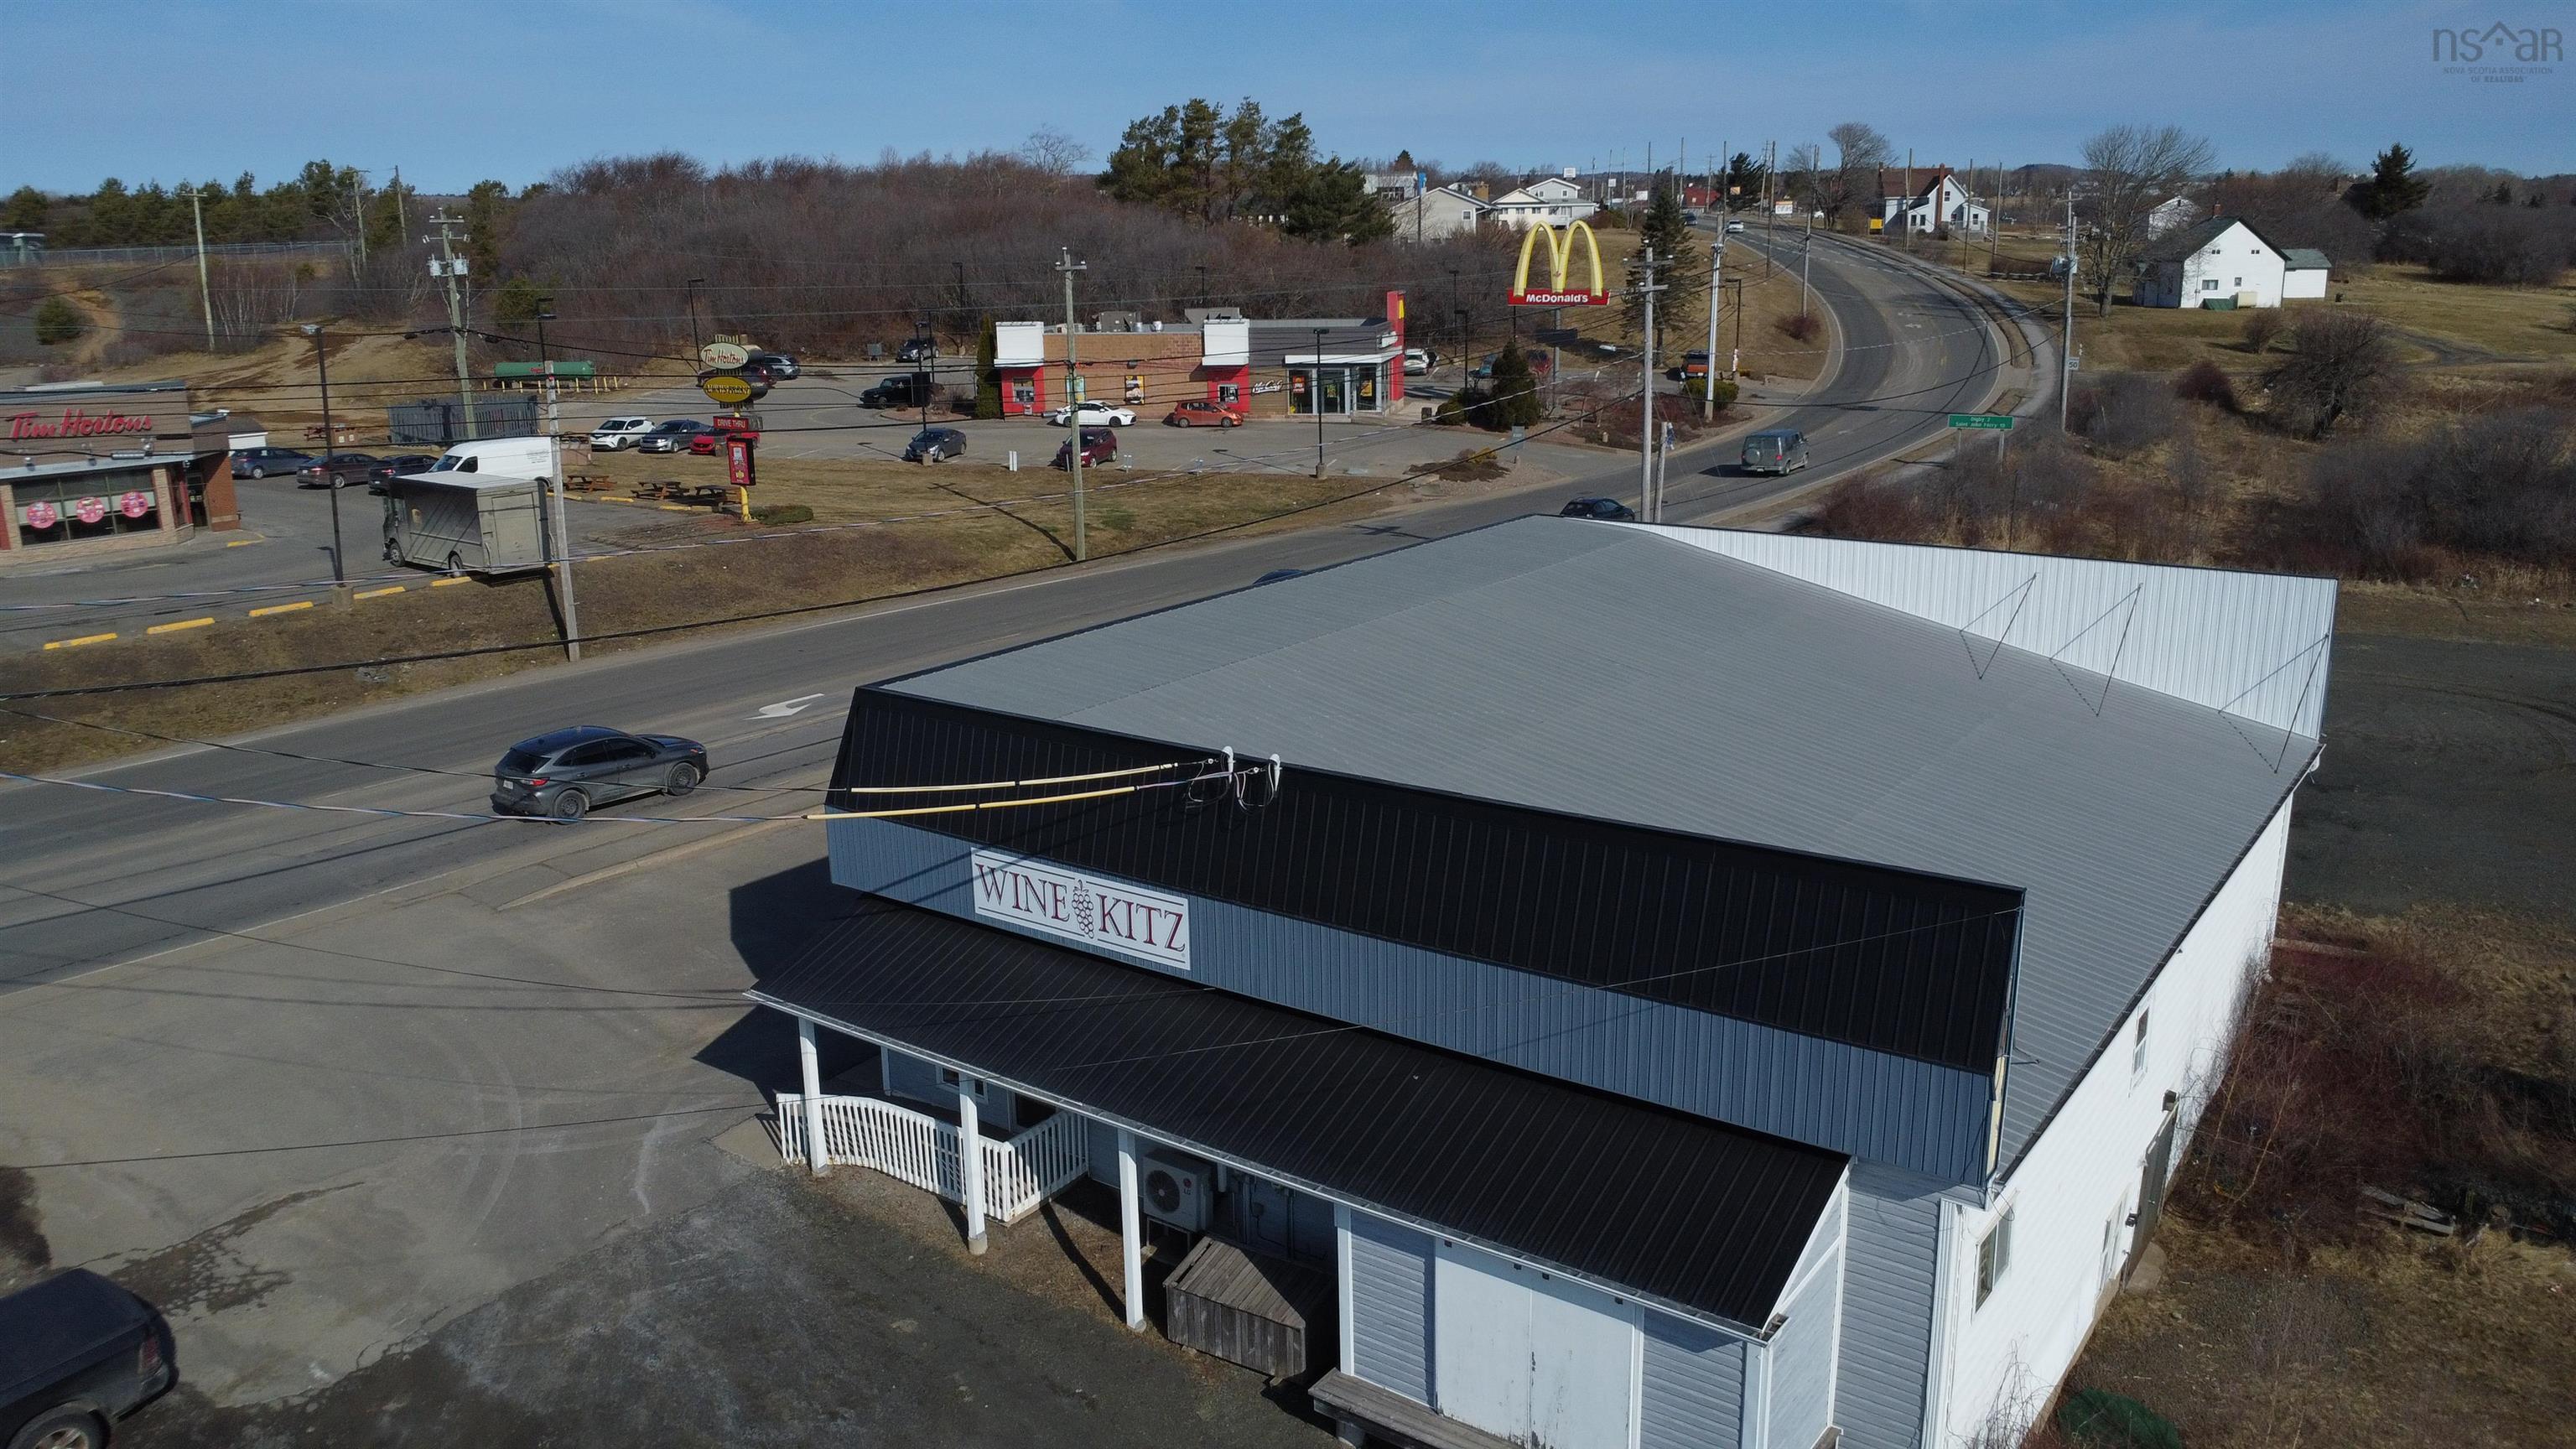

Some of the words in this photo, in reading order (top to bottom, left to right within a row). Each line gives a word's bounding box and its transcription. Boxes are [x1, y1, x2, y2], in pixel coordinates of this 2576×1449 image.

[1525, 293, 1588, 303] McDonald's
[703, 348, 718, 364] Tim
[717, 347, 745, 365] Hortons
[6, 410, 56, 442] Tim
[60, 407, 153, 438] Hortons
[717, 418, 731, 428] DRIVE
[732, 418, 745, 428] THRU
[974, 862, 1070, 922] WINE
[1096, 892, 1186, 953] KITZ
